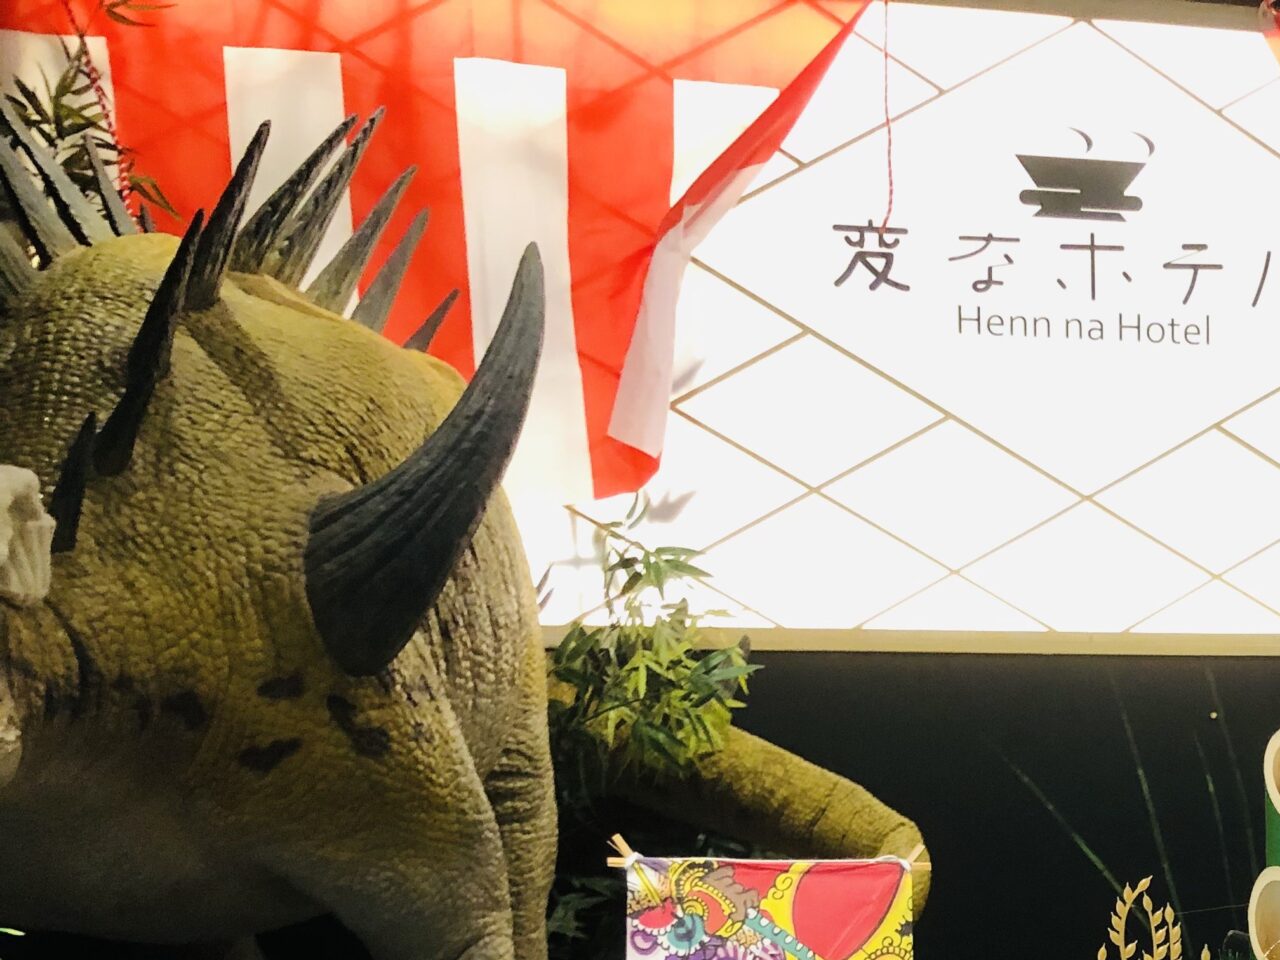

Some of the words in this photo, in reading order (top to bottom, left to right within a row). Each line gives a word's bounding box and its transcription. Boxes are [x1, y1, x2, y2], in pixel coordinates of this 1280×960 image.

[957, 305, 1051, 338] Henn
[1065, 318, 1104, 341] na
[1118, 313, 1210, 345] Hotel
